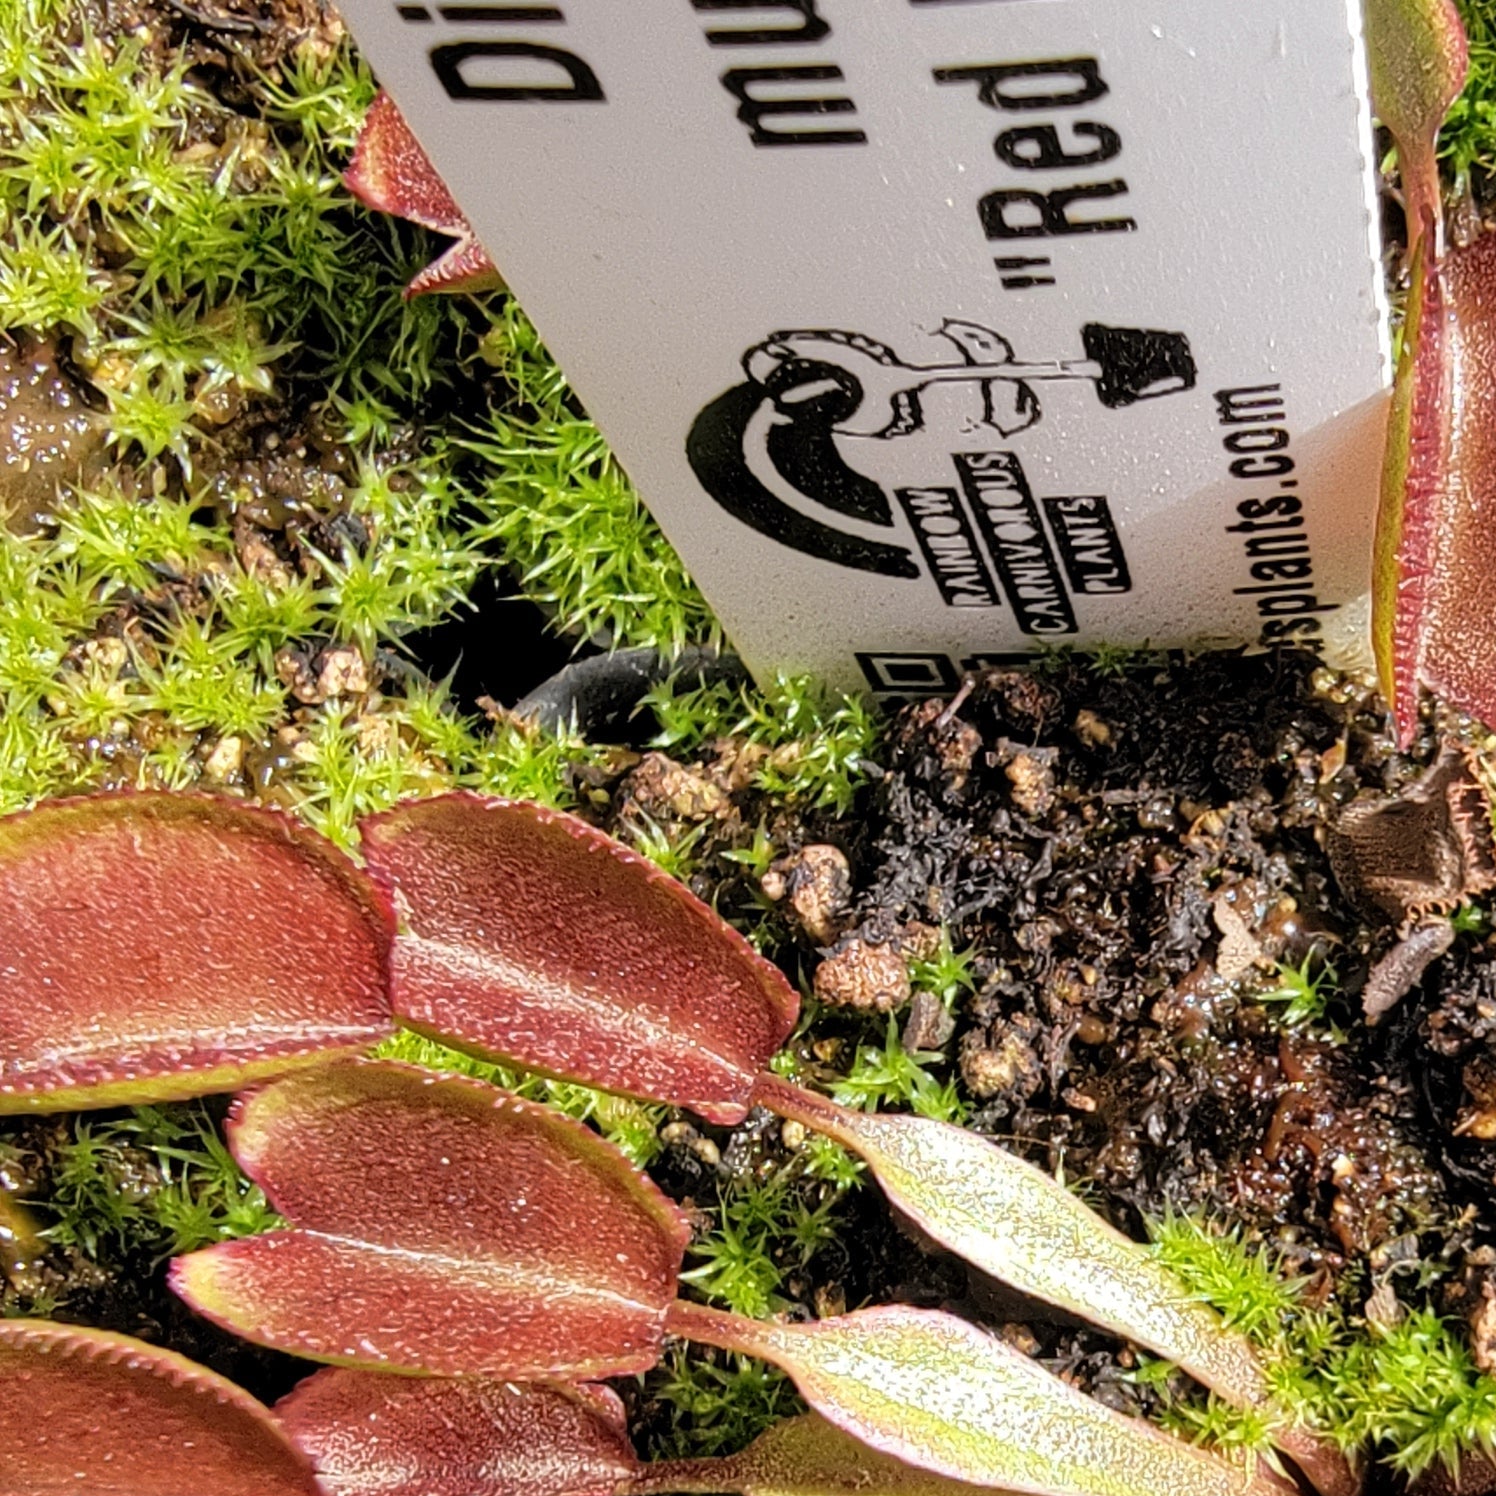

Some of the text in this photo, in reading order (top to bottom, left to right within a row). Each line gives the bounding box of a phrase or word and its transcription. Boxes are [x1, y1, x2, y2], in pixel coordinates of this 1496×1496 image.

[905, 488, 994, 606] RAINBOW
[964, 452, 1069, 634] CARNIVOROUS
[1056, 497, 1127, 593] PLANTS
